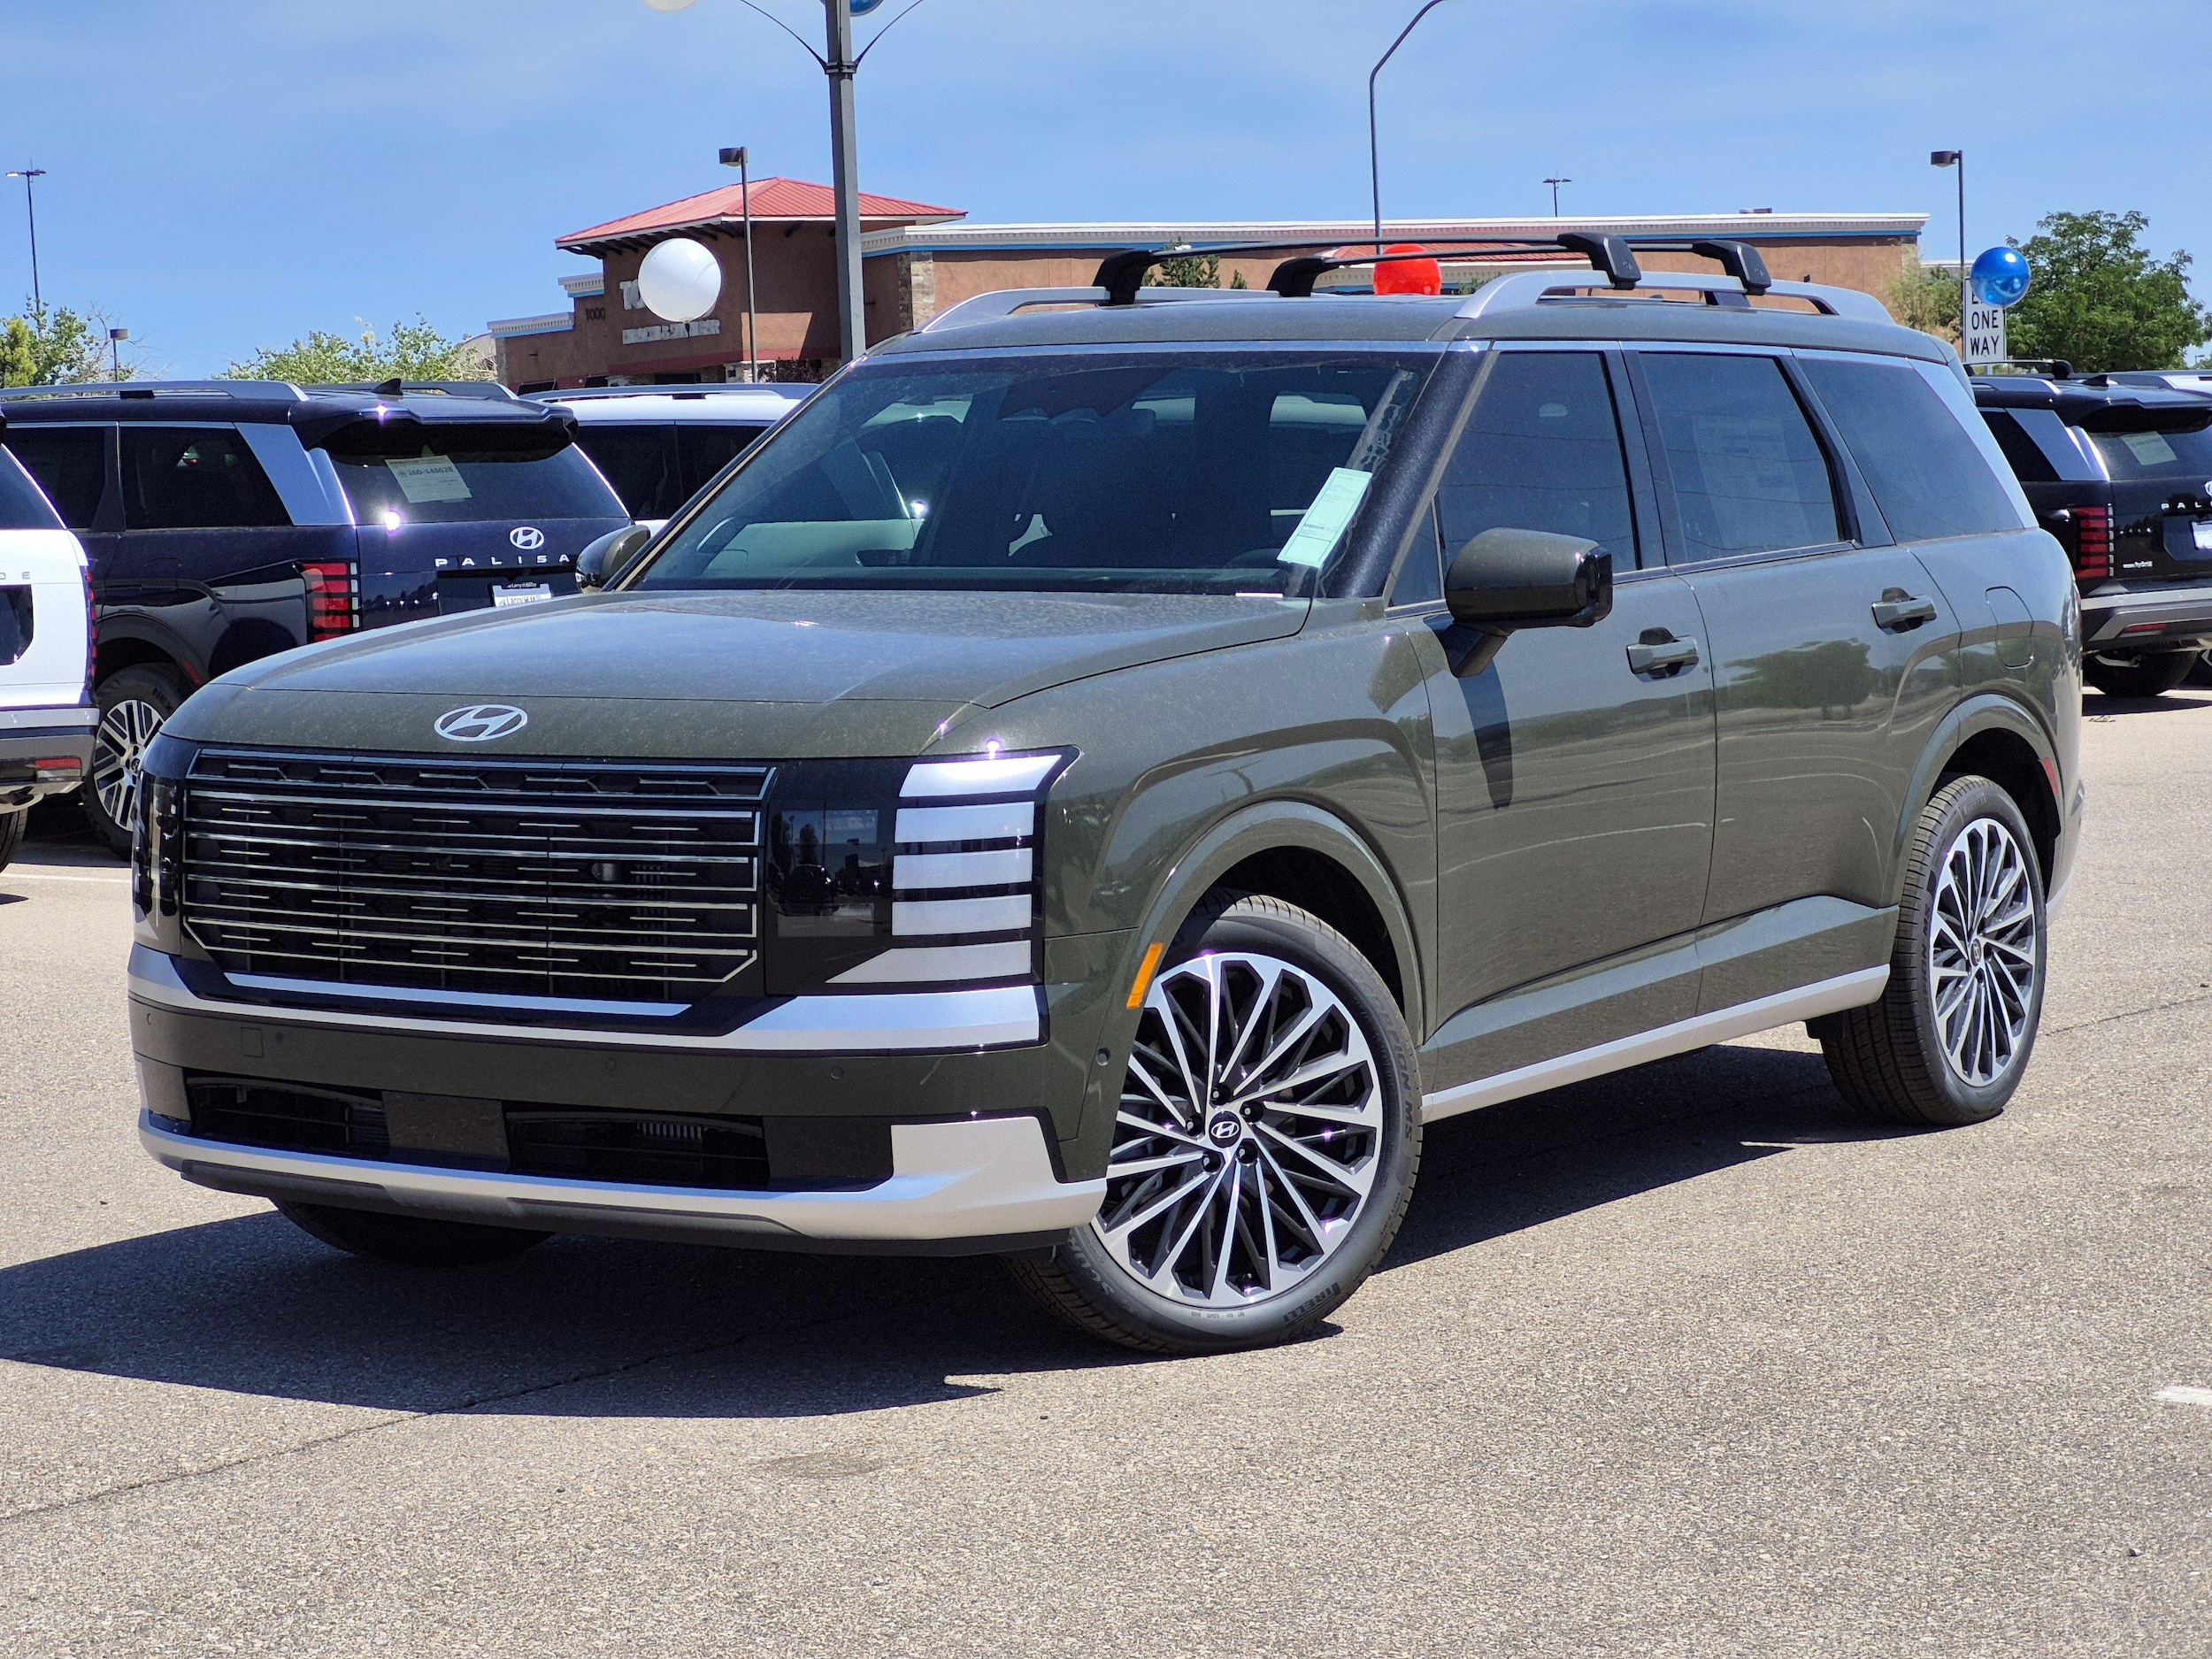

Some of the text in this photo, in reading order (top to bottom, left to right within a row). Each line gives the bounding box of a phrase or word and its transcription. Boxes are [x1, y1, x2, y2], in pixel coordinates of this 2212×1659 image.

[586, 307, 606, 321] 1000
[1971, 310, 1999, 330] ONE
[1970, 335, 2000, 356] WAY
[434, 554, 571, 567] PALISA
[1282, 1282, 1341, 1323] PIRELLI
